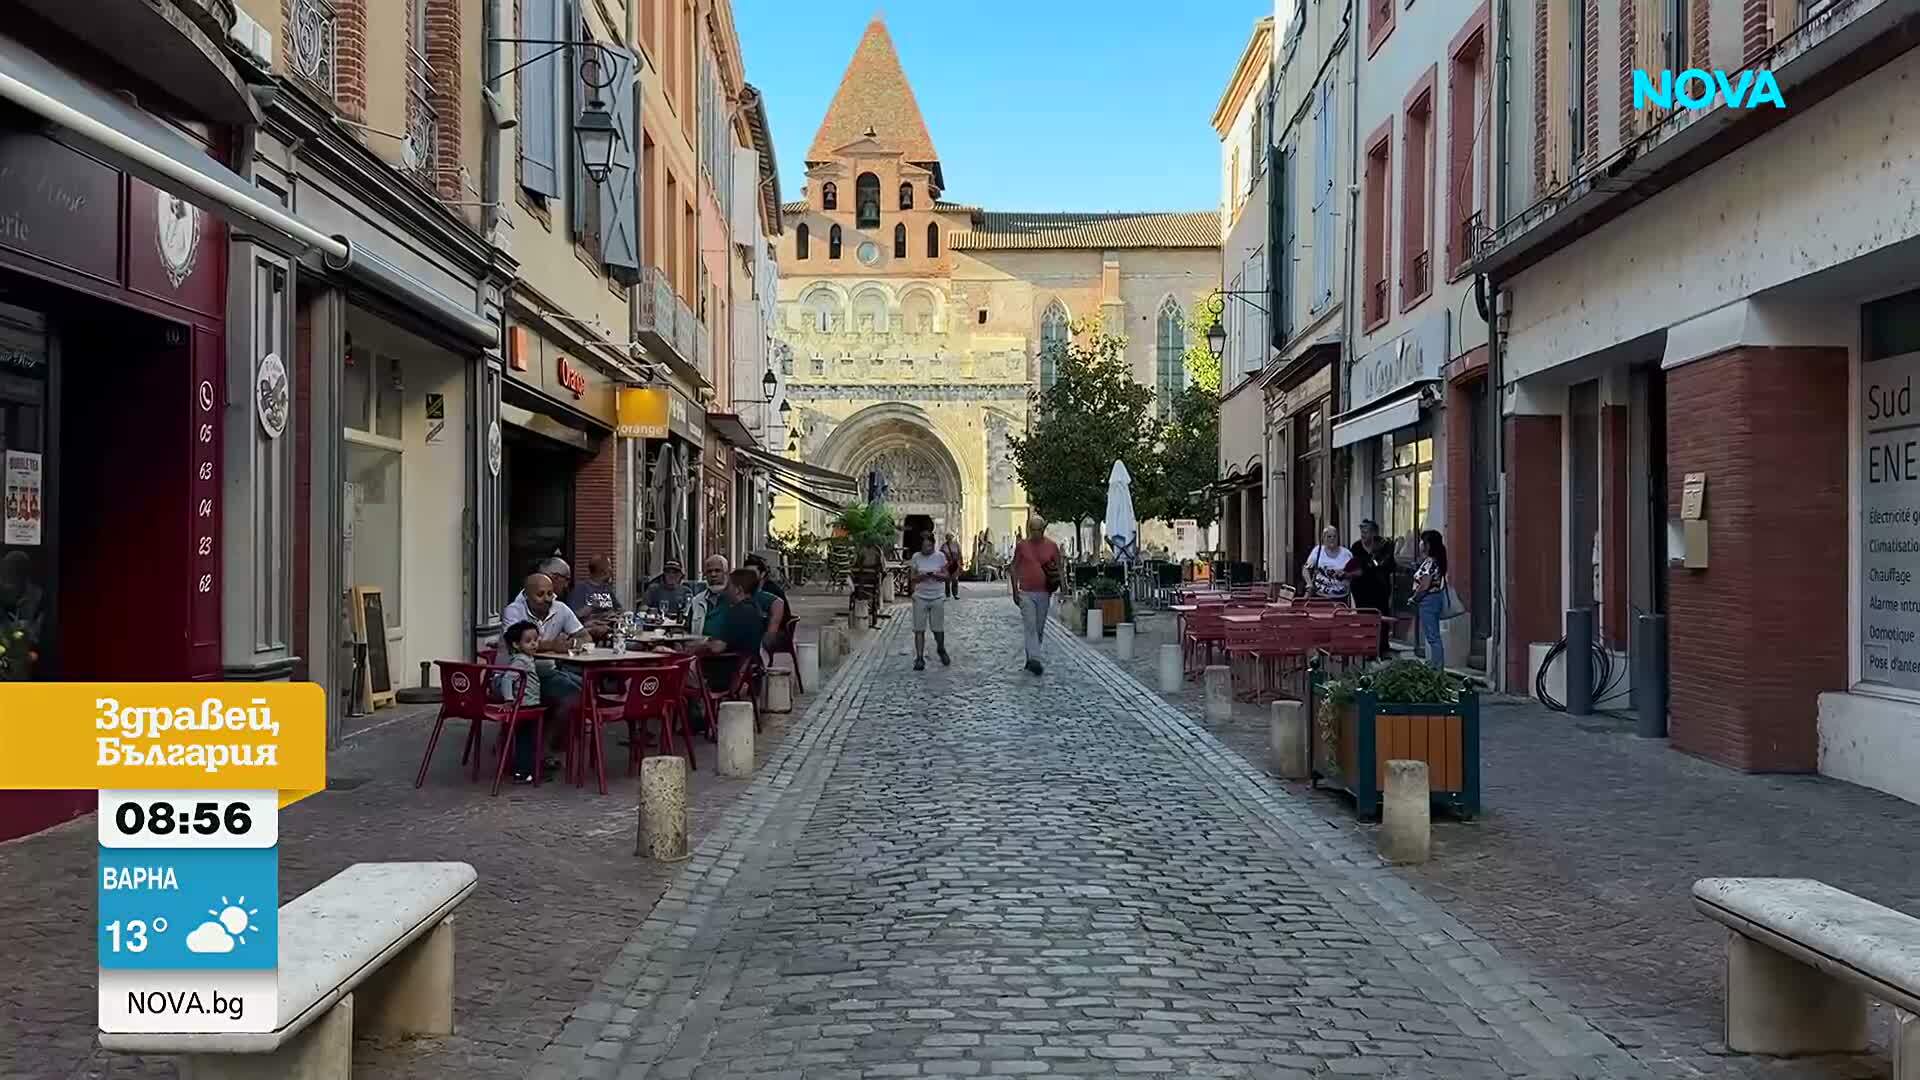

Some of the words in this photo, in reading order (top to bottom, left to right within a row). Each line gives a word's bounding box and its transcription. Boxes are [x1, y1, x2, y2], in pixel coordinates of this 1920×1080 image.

[557, 357, 585, 400] Orange
[1868, 376, 1911, 420] Sud
[200, 424, 212, 443] 05
[620, 424, 665, 436] orange
[200, 462, 212, 480] 63
[1869, 441, 1918, 483] ENE
[199, 499, 212, 517] 04
[199, 536, 212, 555] 23
[199, 574, 212, 592] 62
[1869, 567, 1912, 586] Chauffage
[1869, 596, 1899, 611] Alarme
[1869, 624, 1915, 644] Domotique
[1869, 655, 1889, 670] Pose
